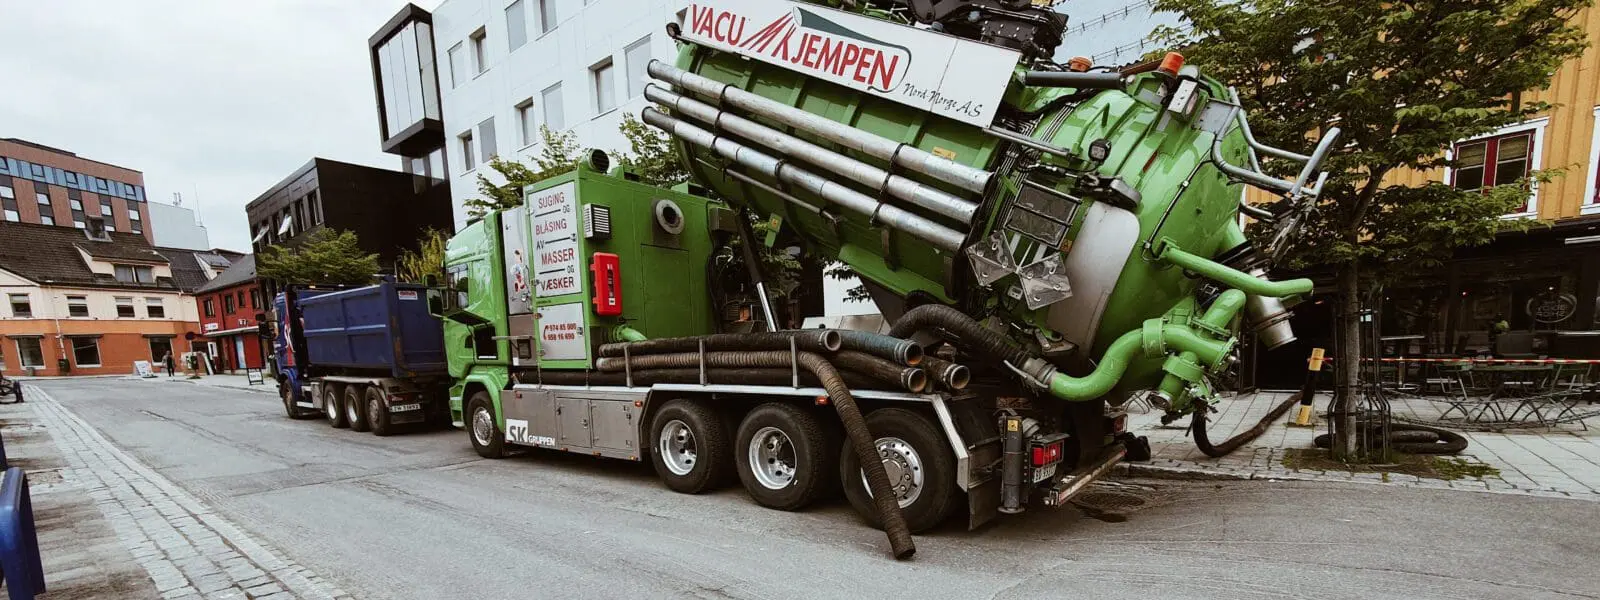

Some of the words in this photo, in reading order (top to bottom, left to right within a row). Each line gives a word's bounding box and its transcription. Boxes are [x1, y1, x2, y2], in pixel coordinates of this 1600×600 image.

[538, 192, 564, 208] SUGING
[562, 204, 570, 213] OG
[535, 218, 567, 235] BLÅSING
[536, 240, 545, 250] AV
[541, 248, 574, 265] MASSER
[567, 265, 575, 274] OG
[540, 276, 575, 291] VÆSKER
[510, 425, 526, 442] SK
[528, 435, 556, 446] GRUPPEN
